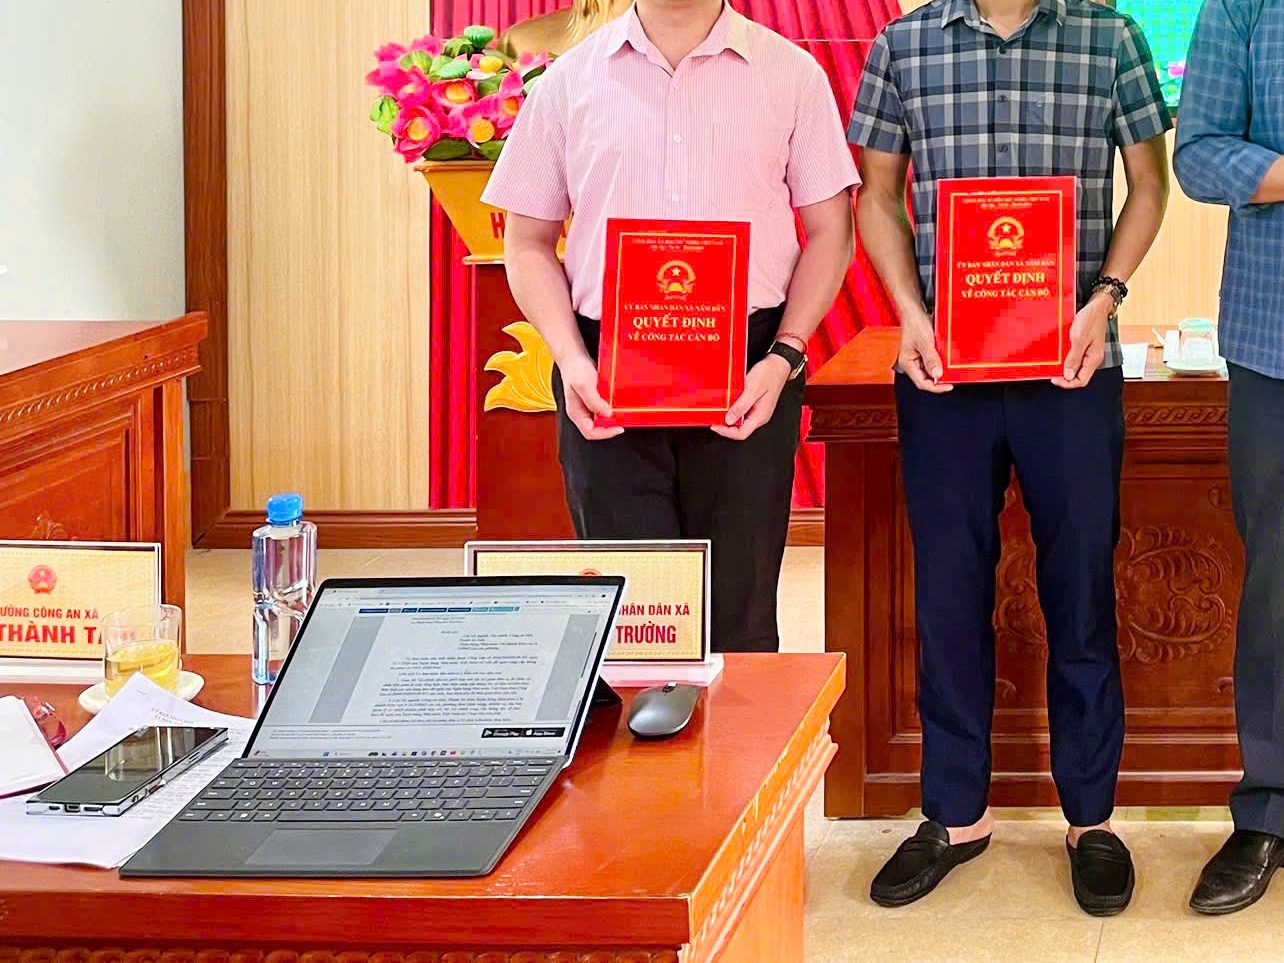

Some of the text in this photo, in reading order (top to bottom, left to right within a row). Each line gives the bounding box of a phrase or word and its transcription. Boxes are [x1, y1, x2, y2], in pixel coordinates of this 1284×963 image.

[965, 268, 1045, 286] QUYẾT ĐỊNH
[632, 312, 716, 330] QUYẾT ĐỊNH
[33, 606, 63, 618] CÔNG
[66, 609, 81, 619] AN
[619, 603, 645, 616] HÂN
[648, 603, 672, 616] DÂN
[616, 620, 677, 644] TRƯỜNG
